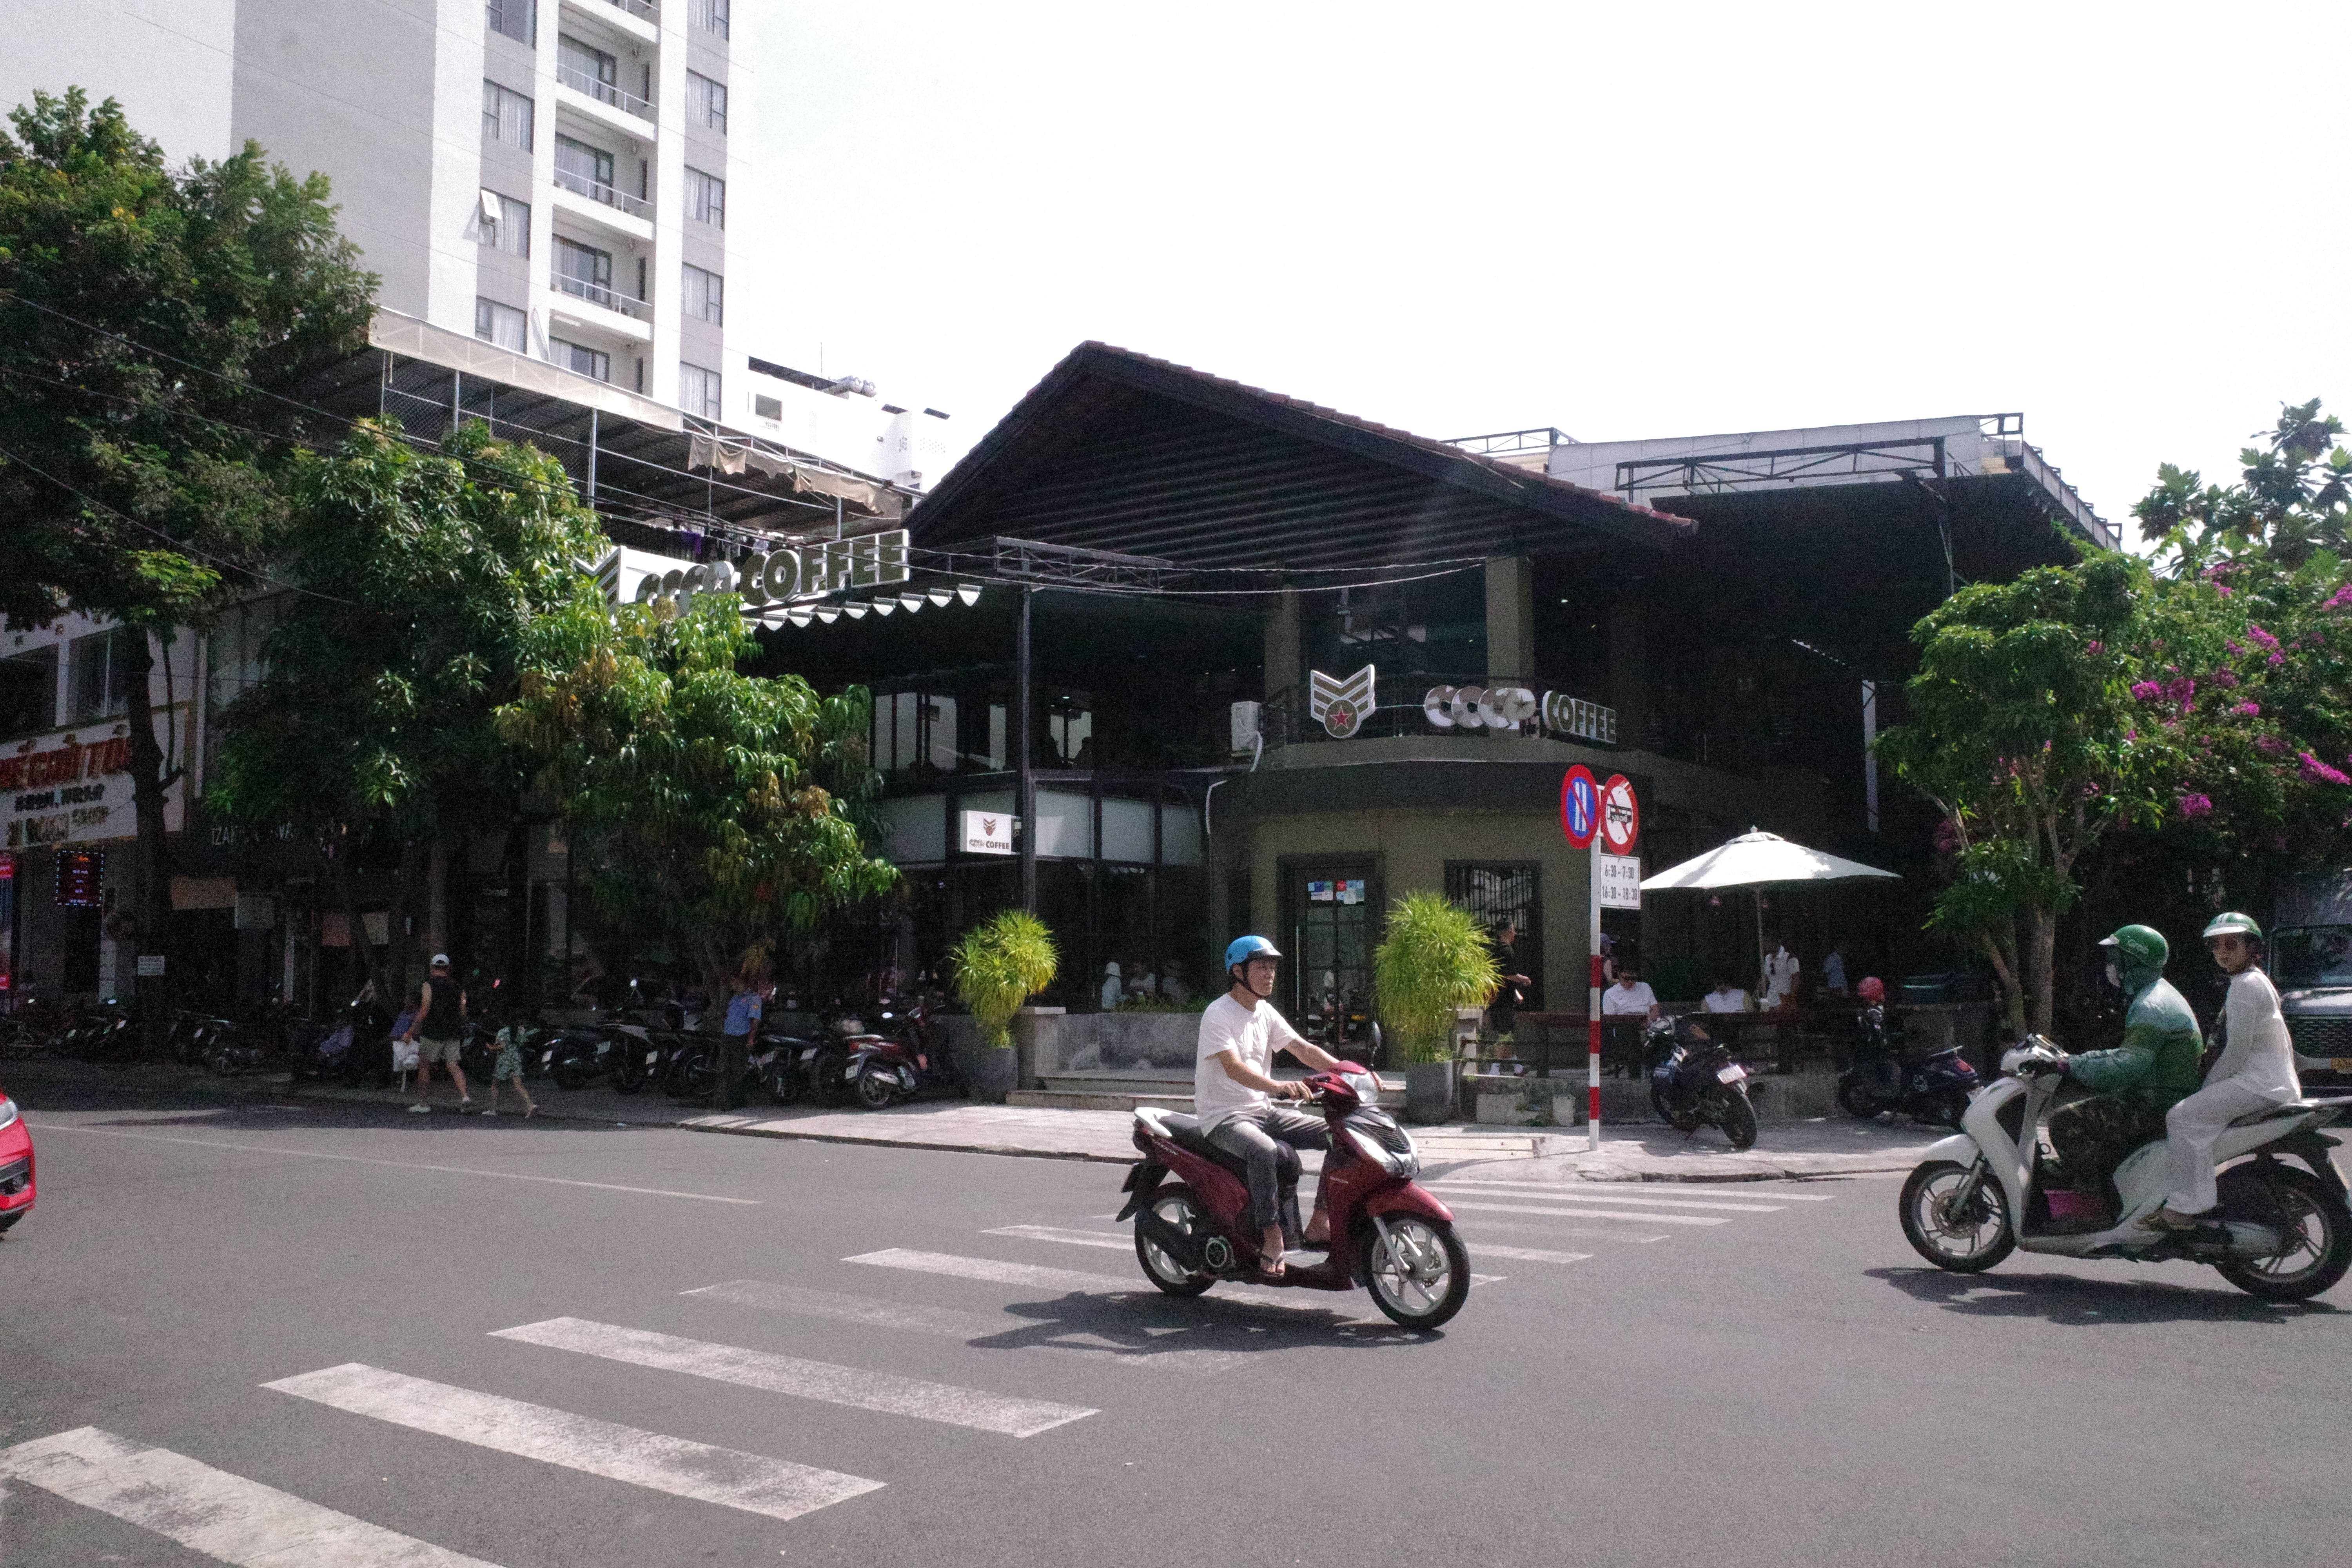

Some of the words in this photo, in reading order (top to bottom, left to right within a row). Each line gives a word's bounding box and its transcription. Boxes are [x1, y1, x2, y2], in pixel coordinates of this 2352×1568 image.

[744, 529, 909, 607] COFFEE
[1542, 690, 1616, 744] COFFEE
[985, 840, 1009, 849] COFFEE
[1605, 864, 1617, 878] 6:30
[1622, 866, 1634, 879] 7:30
[1602, 886, 1617, 899] 16:30
